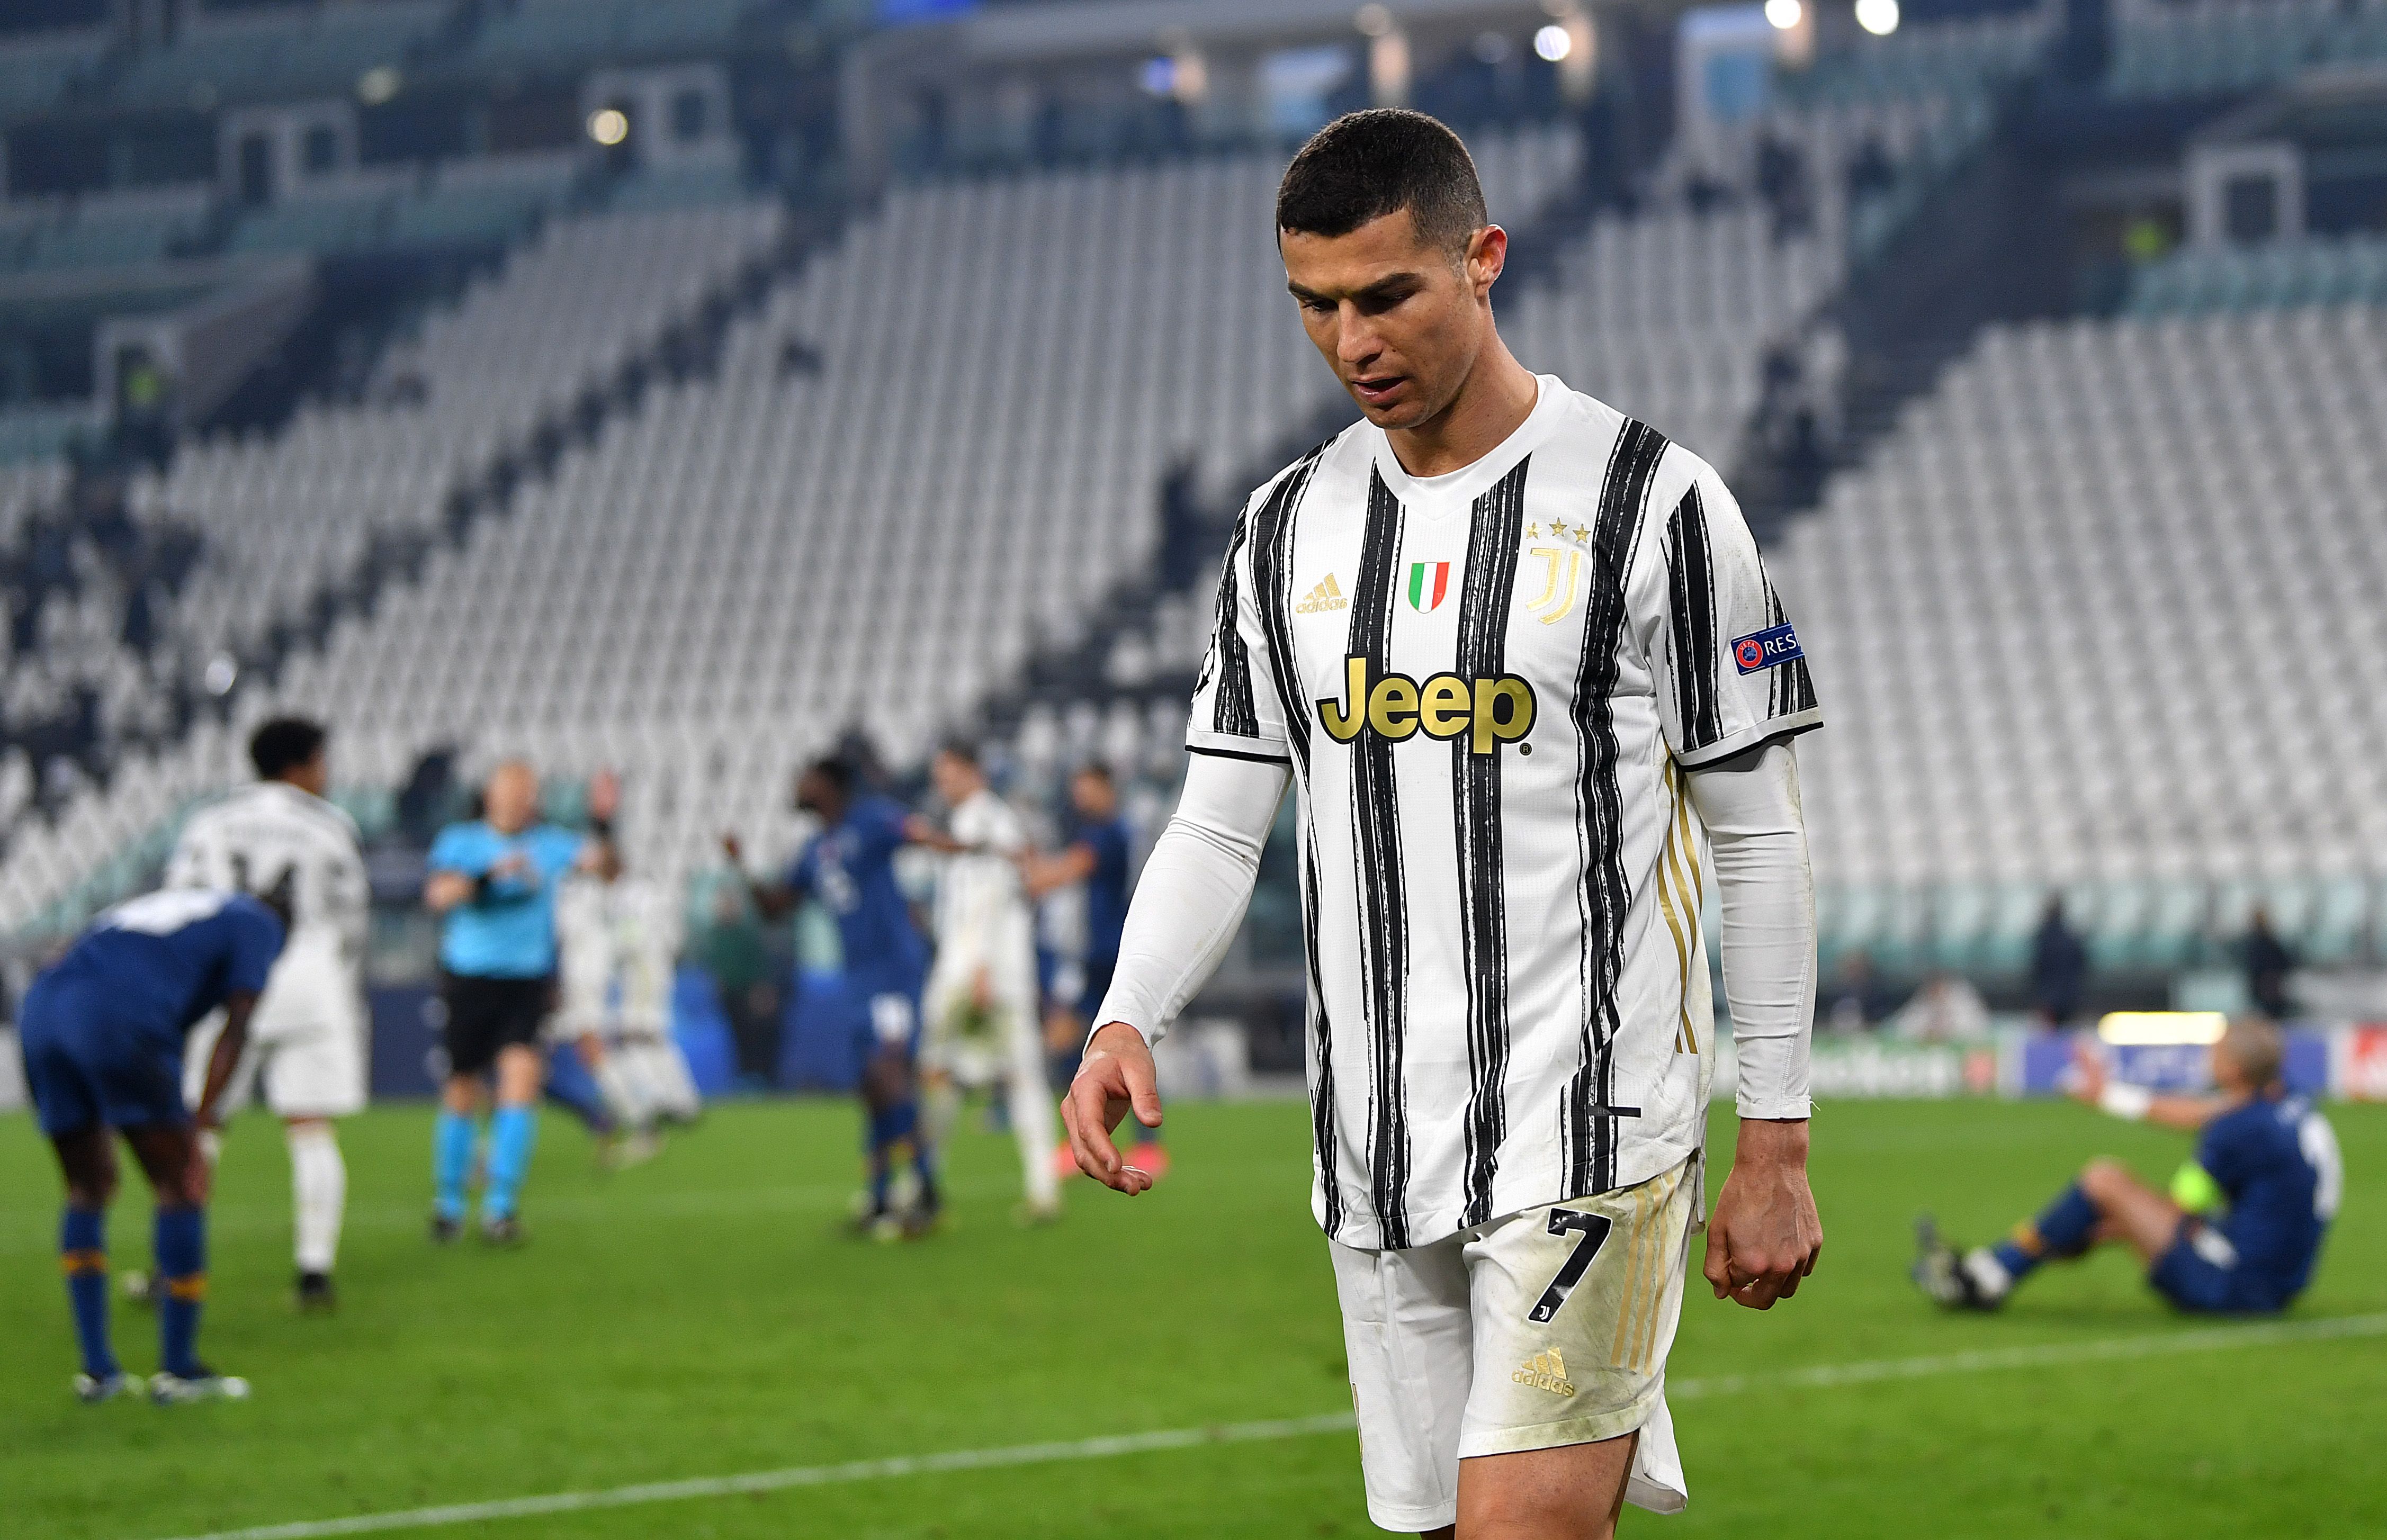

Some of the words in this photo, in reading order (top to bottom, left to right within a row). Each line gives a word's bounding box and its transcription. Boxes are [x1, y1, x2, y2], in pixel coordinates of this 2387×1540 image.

[1296, 597, 1348, 614] adidas
[1764, 633, 1800, 656] RES
[1317, 655, 1536, 754] Jeep
[1527, 1208, 1613, 1325] 7
[1512, 1369, 1574, 1398] adidas
